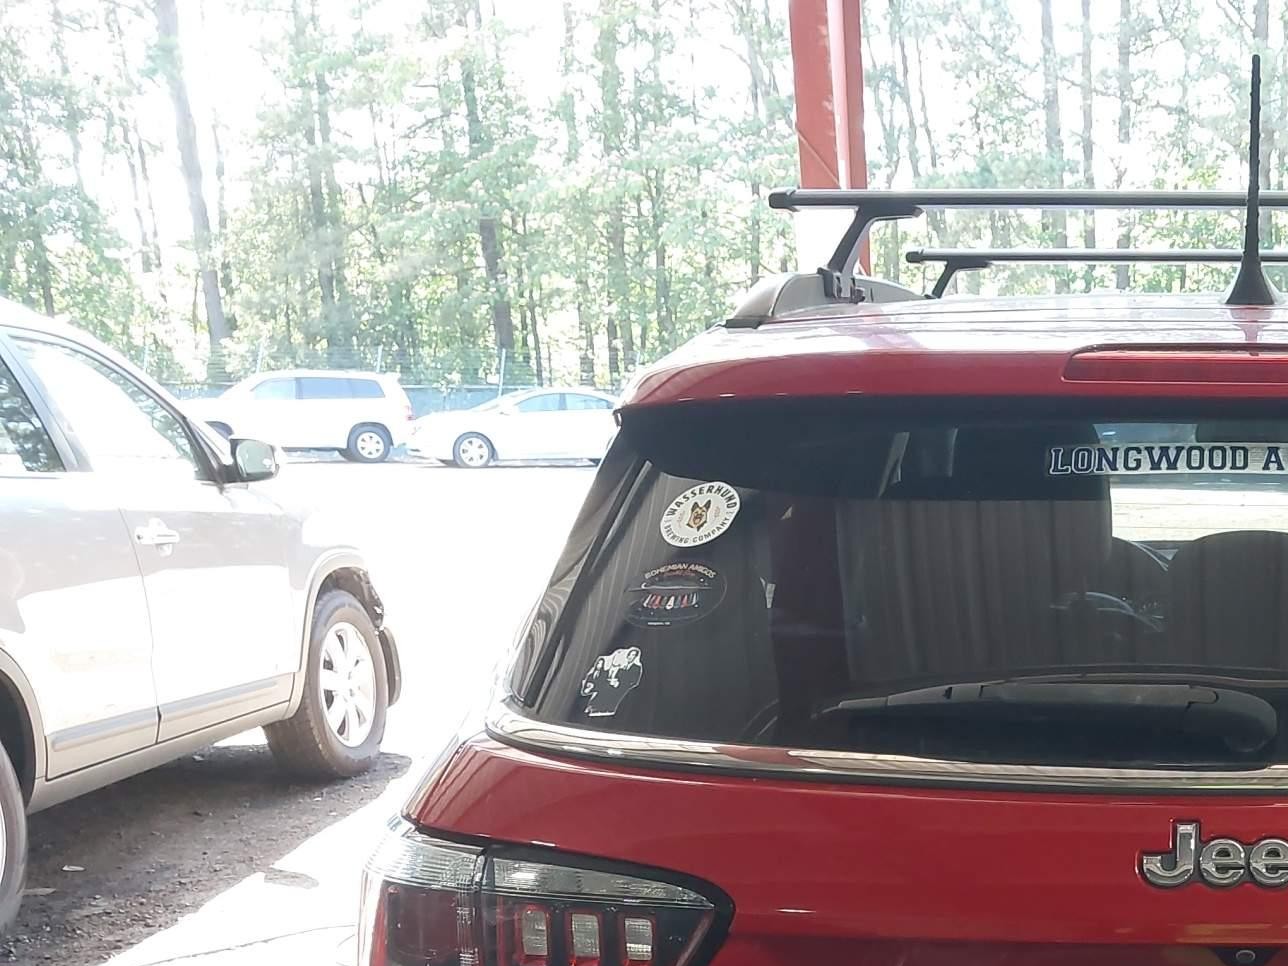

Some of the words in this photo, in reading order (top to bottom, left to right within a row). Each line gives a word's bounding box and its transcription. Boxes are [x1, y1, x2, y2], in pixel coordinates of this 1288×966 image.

[1048, 445, 1249, 475] LONGWOOD
[666, 485, 737, 516] WASSERHUND
[664, 524, 690, 544] BREWING
[692, 517, 730, 543] COMPANY
